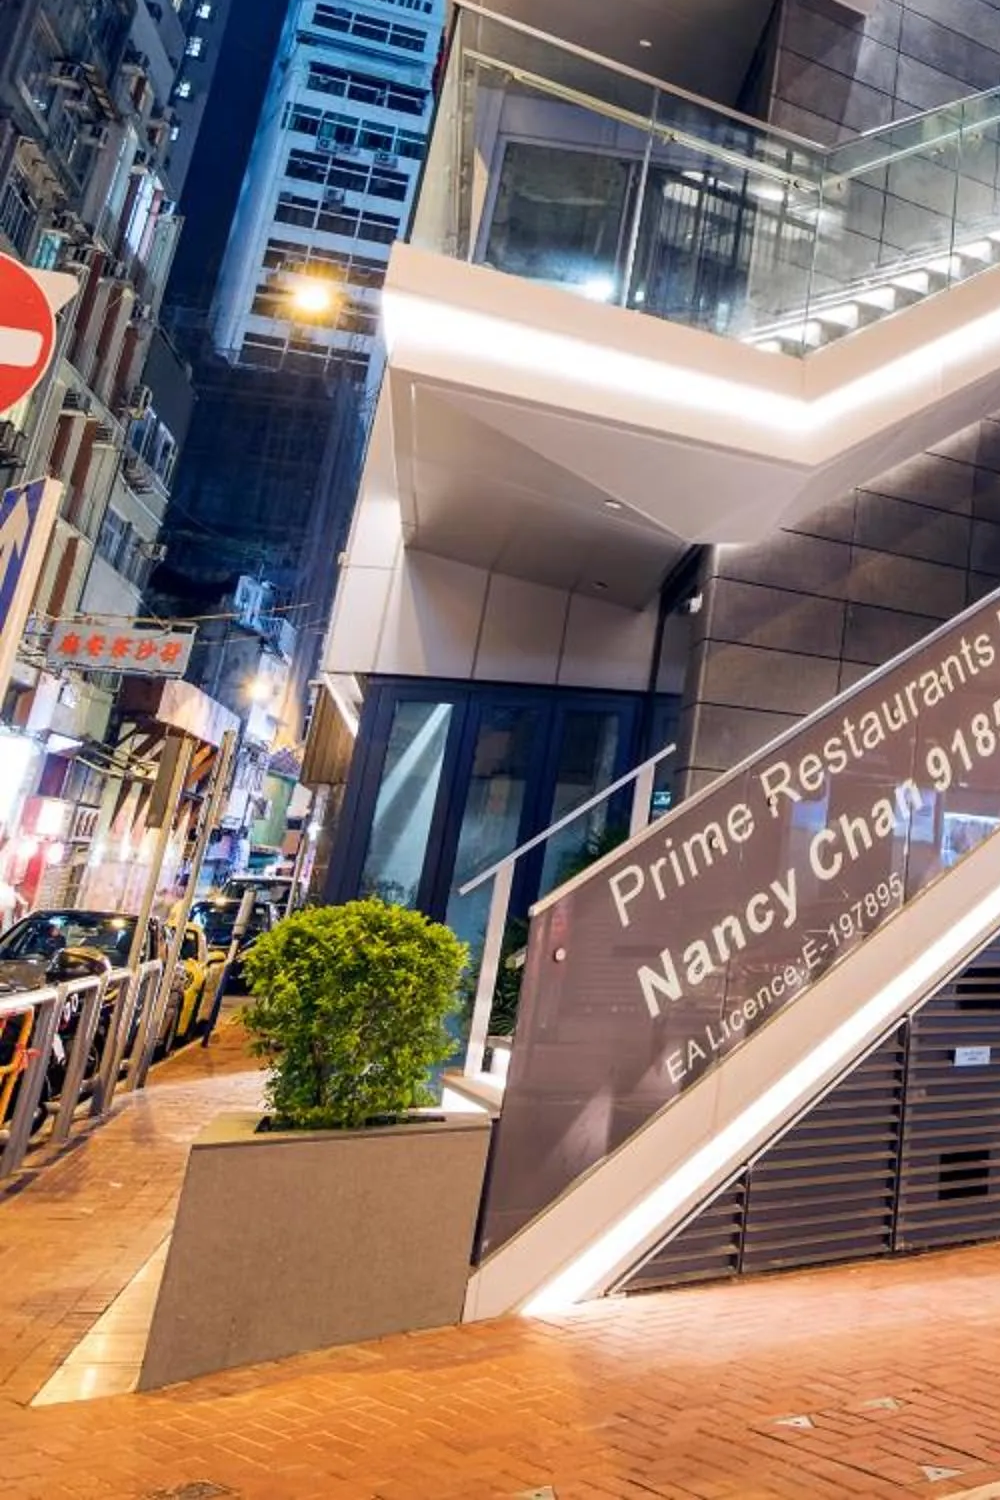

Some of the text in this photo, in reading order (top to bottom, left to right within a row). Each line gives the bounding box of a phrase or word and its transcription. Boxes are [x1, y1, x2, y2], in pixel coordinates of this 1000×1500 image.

[608, 802, 755, 928] Prime
[760, 632, 996, 818] Restaurants
[637, 867, 801, 1018] Nancy
[808, 778, 923, 882] Chan
[665, 1039, 704, 1084] EA
